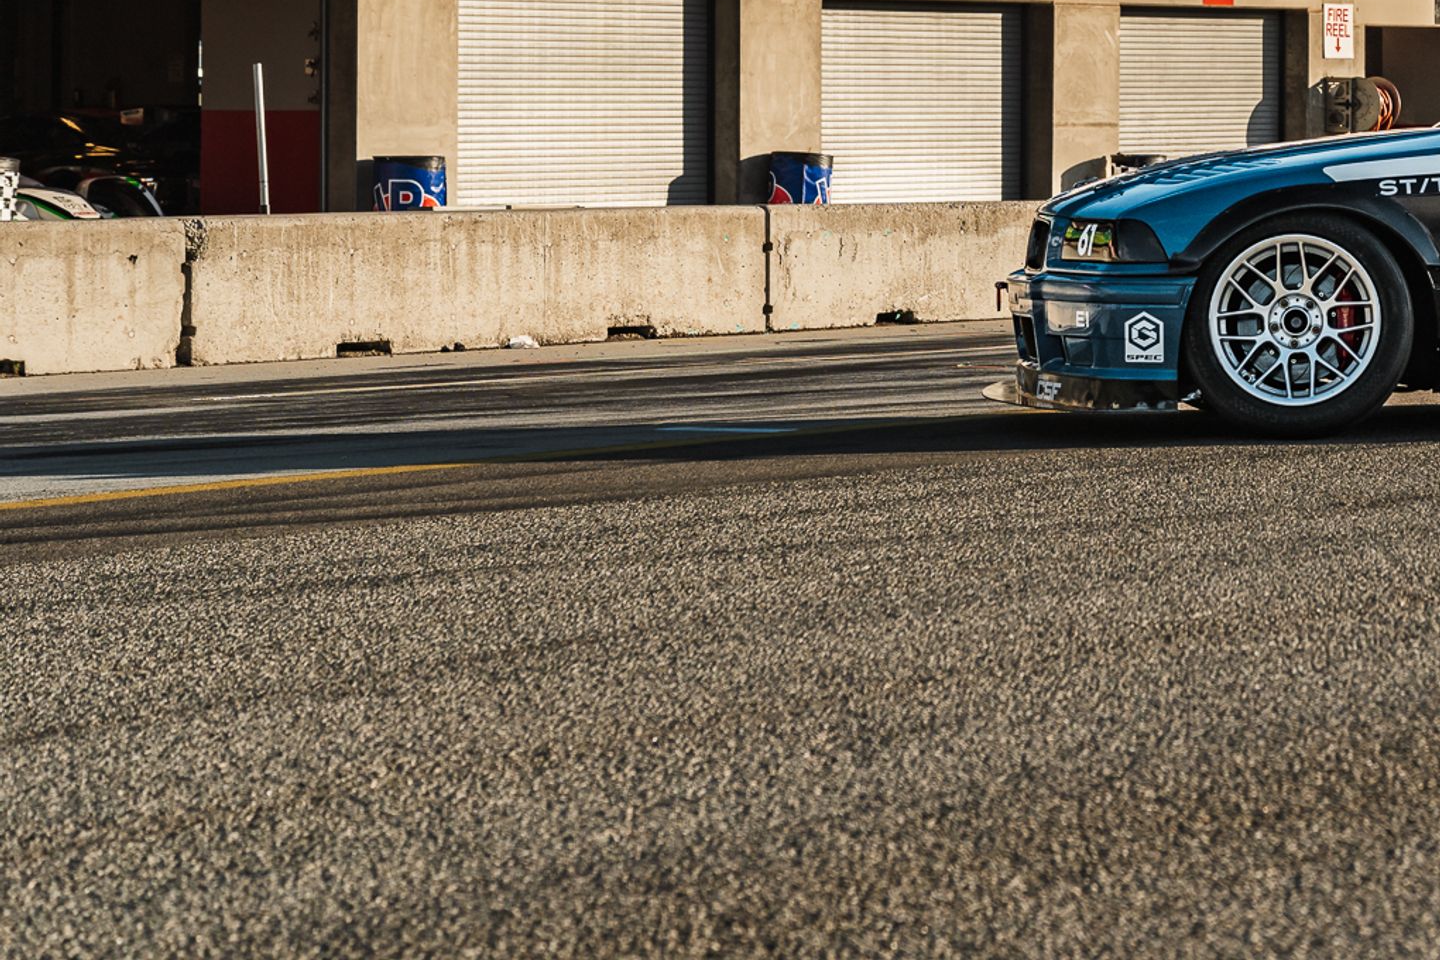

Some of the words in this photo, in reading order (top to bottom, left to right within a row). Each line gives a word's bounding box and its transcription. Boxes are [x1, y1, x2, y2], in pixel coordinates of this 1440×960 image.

[1327, 8, 1349, 22] FIRE
[1326, 23, 1350, 38] REEL
[1077, 223, 1098, 257] 61
[1126, 354, 1163, 362] SPEC
[1036, 380, 1061, 400] CSF
